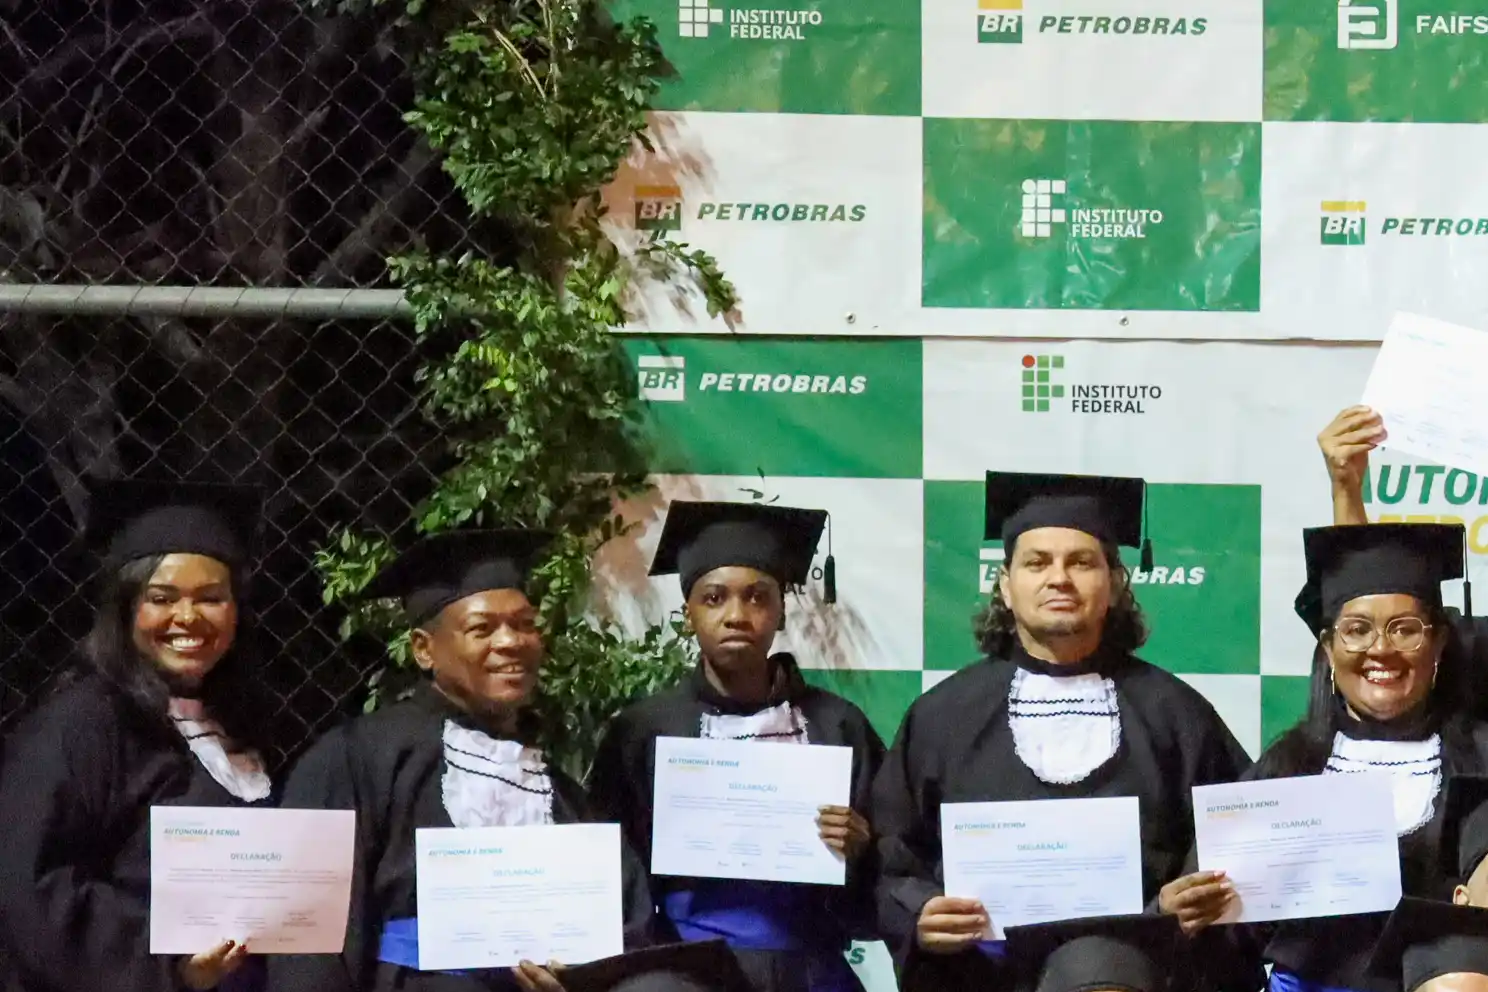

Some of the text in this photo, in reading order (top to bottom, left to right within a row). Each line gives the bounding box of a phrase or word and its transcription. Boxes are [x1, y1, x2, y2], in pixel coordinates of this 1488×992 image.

[730, 9, 822, 25] INSTITUTO
[730, 24, 806, 40] FEDERAL
[980, 15, 1208, 36] BR PETROBRAS
[698, 203, 867, 222] PETROBRAS
[1071, 209, 1163, 225] INSTITUTO
[1071, 224, 1146, 239] FEDERAL
[1323, 217, 1363, 236] BR
[699, 373, 867, 394] PETROBRAS
[1071, 384, 1162, 400] INSTITUTO
[1071, 399, 1145, 414] FEDERAL
